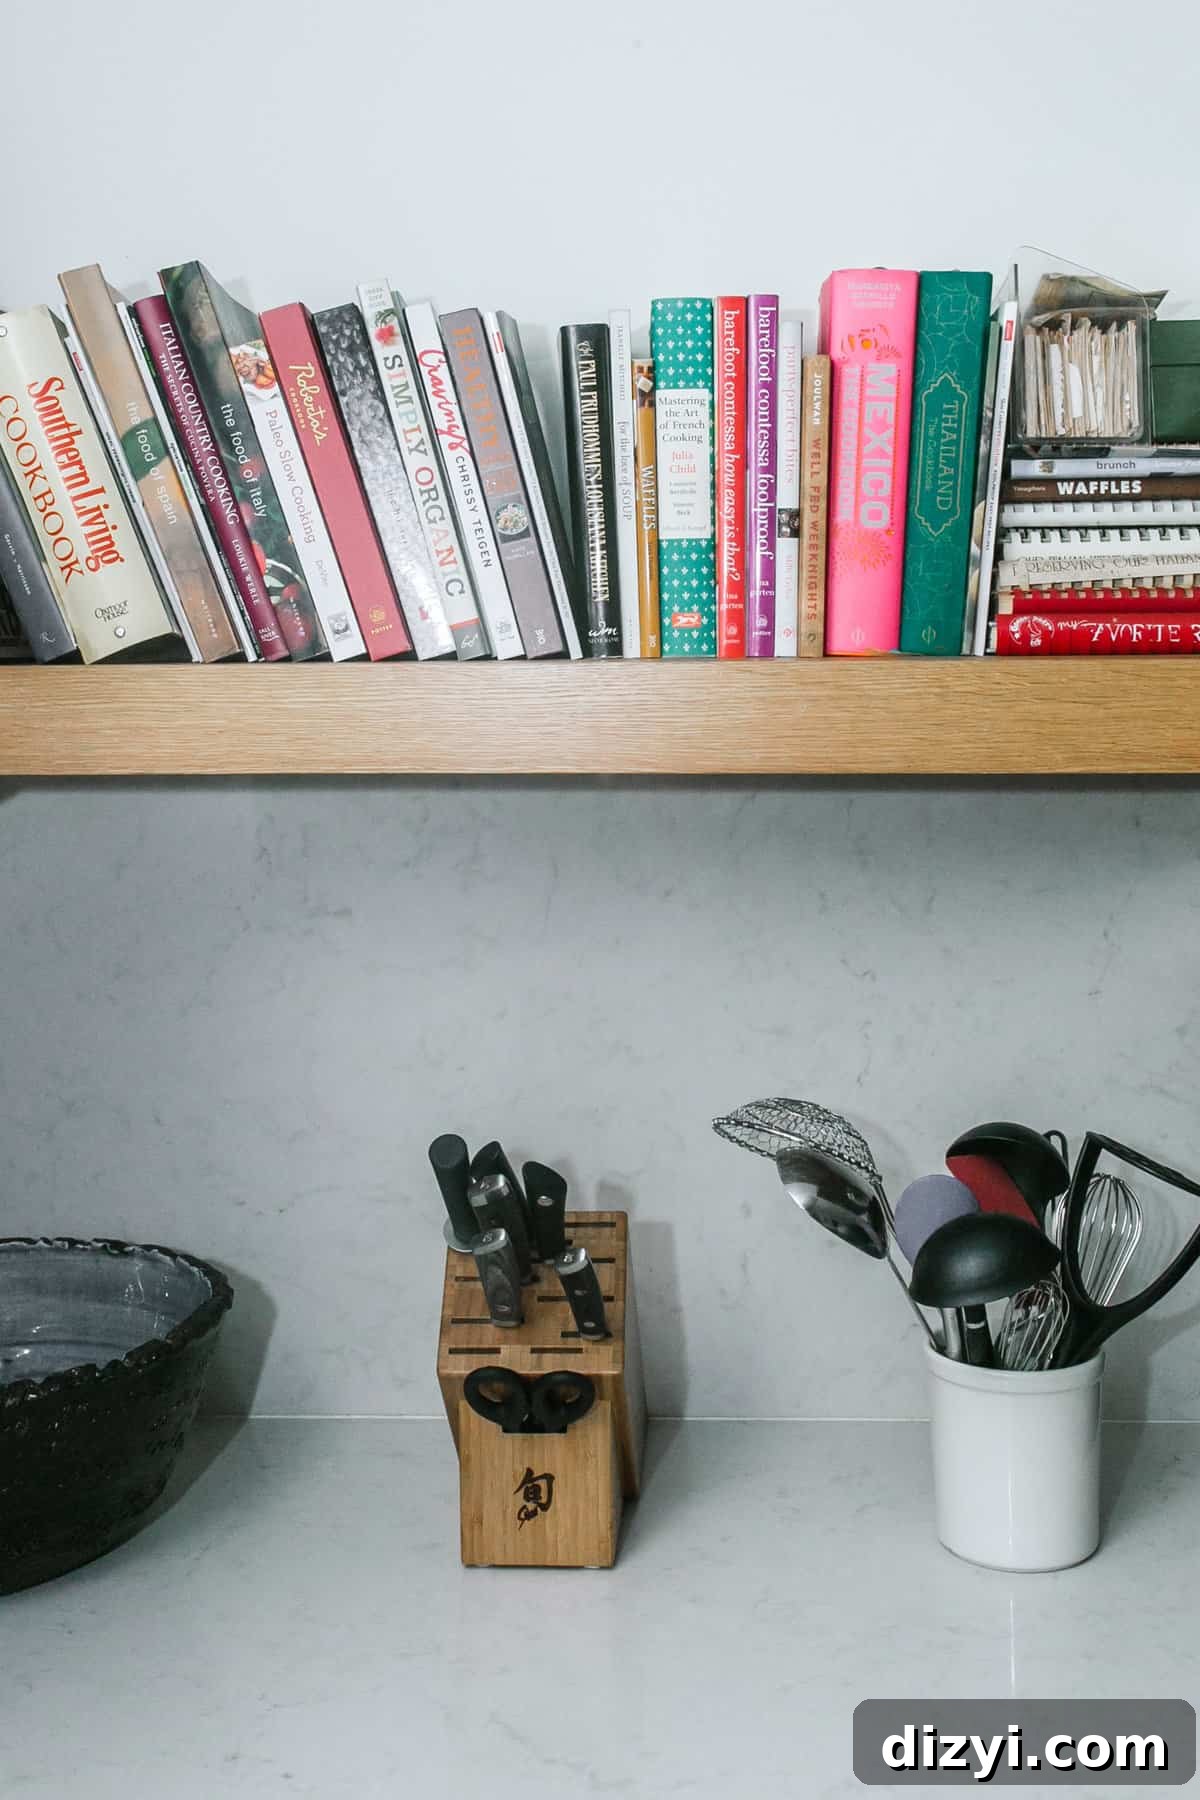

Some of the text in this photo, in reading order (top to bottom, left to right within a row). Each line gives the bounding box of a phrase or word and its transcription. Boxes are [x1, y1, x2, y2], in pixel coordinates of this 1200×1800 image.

[578, 359, 597, 389] PAUL
[723, 310, 740, 378] barefoot
[159, 353, 170, 371] THE
[167, 374, 184, 413] SECRETS
[180, 415, 189, 427] OF
[186, 428, 202, 465] CUCINA
[199, 464, 217, 502] POVERA
[160, 322, 189, 380] ITALIAN
[181, 383, 215, 453] COUNTRY
[207, 456, 240, 525] COOKING
[289, 362, 329, 447] Roberta's
[418, 349, 473, 459] Cravings
[616, 420, 630, 435] for
[658, 397, 706, 408] Mastering
[659, 420, 706, 430] of French
[665, 408, 699, 418] the Art
[723, 382, 738, 450] contessa
[752, 305, 776, 560] barefoot contessa foolproof
[126, 401, 177, 525] the food of spain
[221, 403, 268, 517] the food of italy
[619, 438, 631, 452] the
[662, 433, 704, 444] Cooking
[669, 463, 697, 474] Child
[672, 451, 693, 461] Julia
[723, 453, 740, 487] how
[860, 363, 897, 529] MEXICO
[937, 400, 959, 511] THAILAND
[1096, 460, 1137, 470] brunch
[0, 395, 85, 584] COOKBOOK
[27, 376, 91, 491] Southern
[71, 485, 125, 573] Living
[266, 409, 316, 544] Paleo Slow Cooking
[383, 354, 428, 457] SIMPLY
[415, 466, 466, 597] ORGANIC
[621, 489, 632, 521] SOUP
[640, 465, 656, 531] WAFFLES
[720, 488, 736, 524] easy
[807, 373, 824, 621] JOULWAN WELL FED WEEKNIGHTS
[1056, 480, 1143, 496] WAFFLES
[455, 455, 493, 568] CHRISSY TEIGEN
[232, 539, 249, 571] LOUKIE
[245, 574, 260, 605] WERLE
[725, 540, 741, 581] that?
